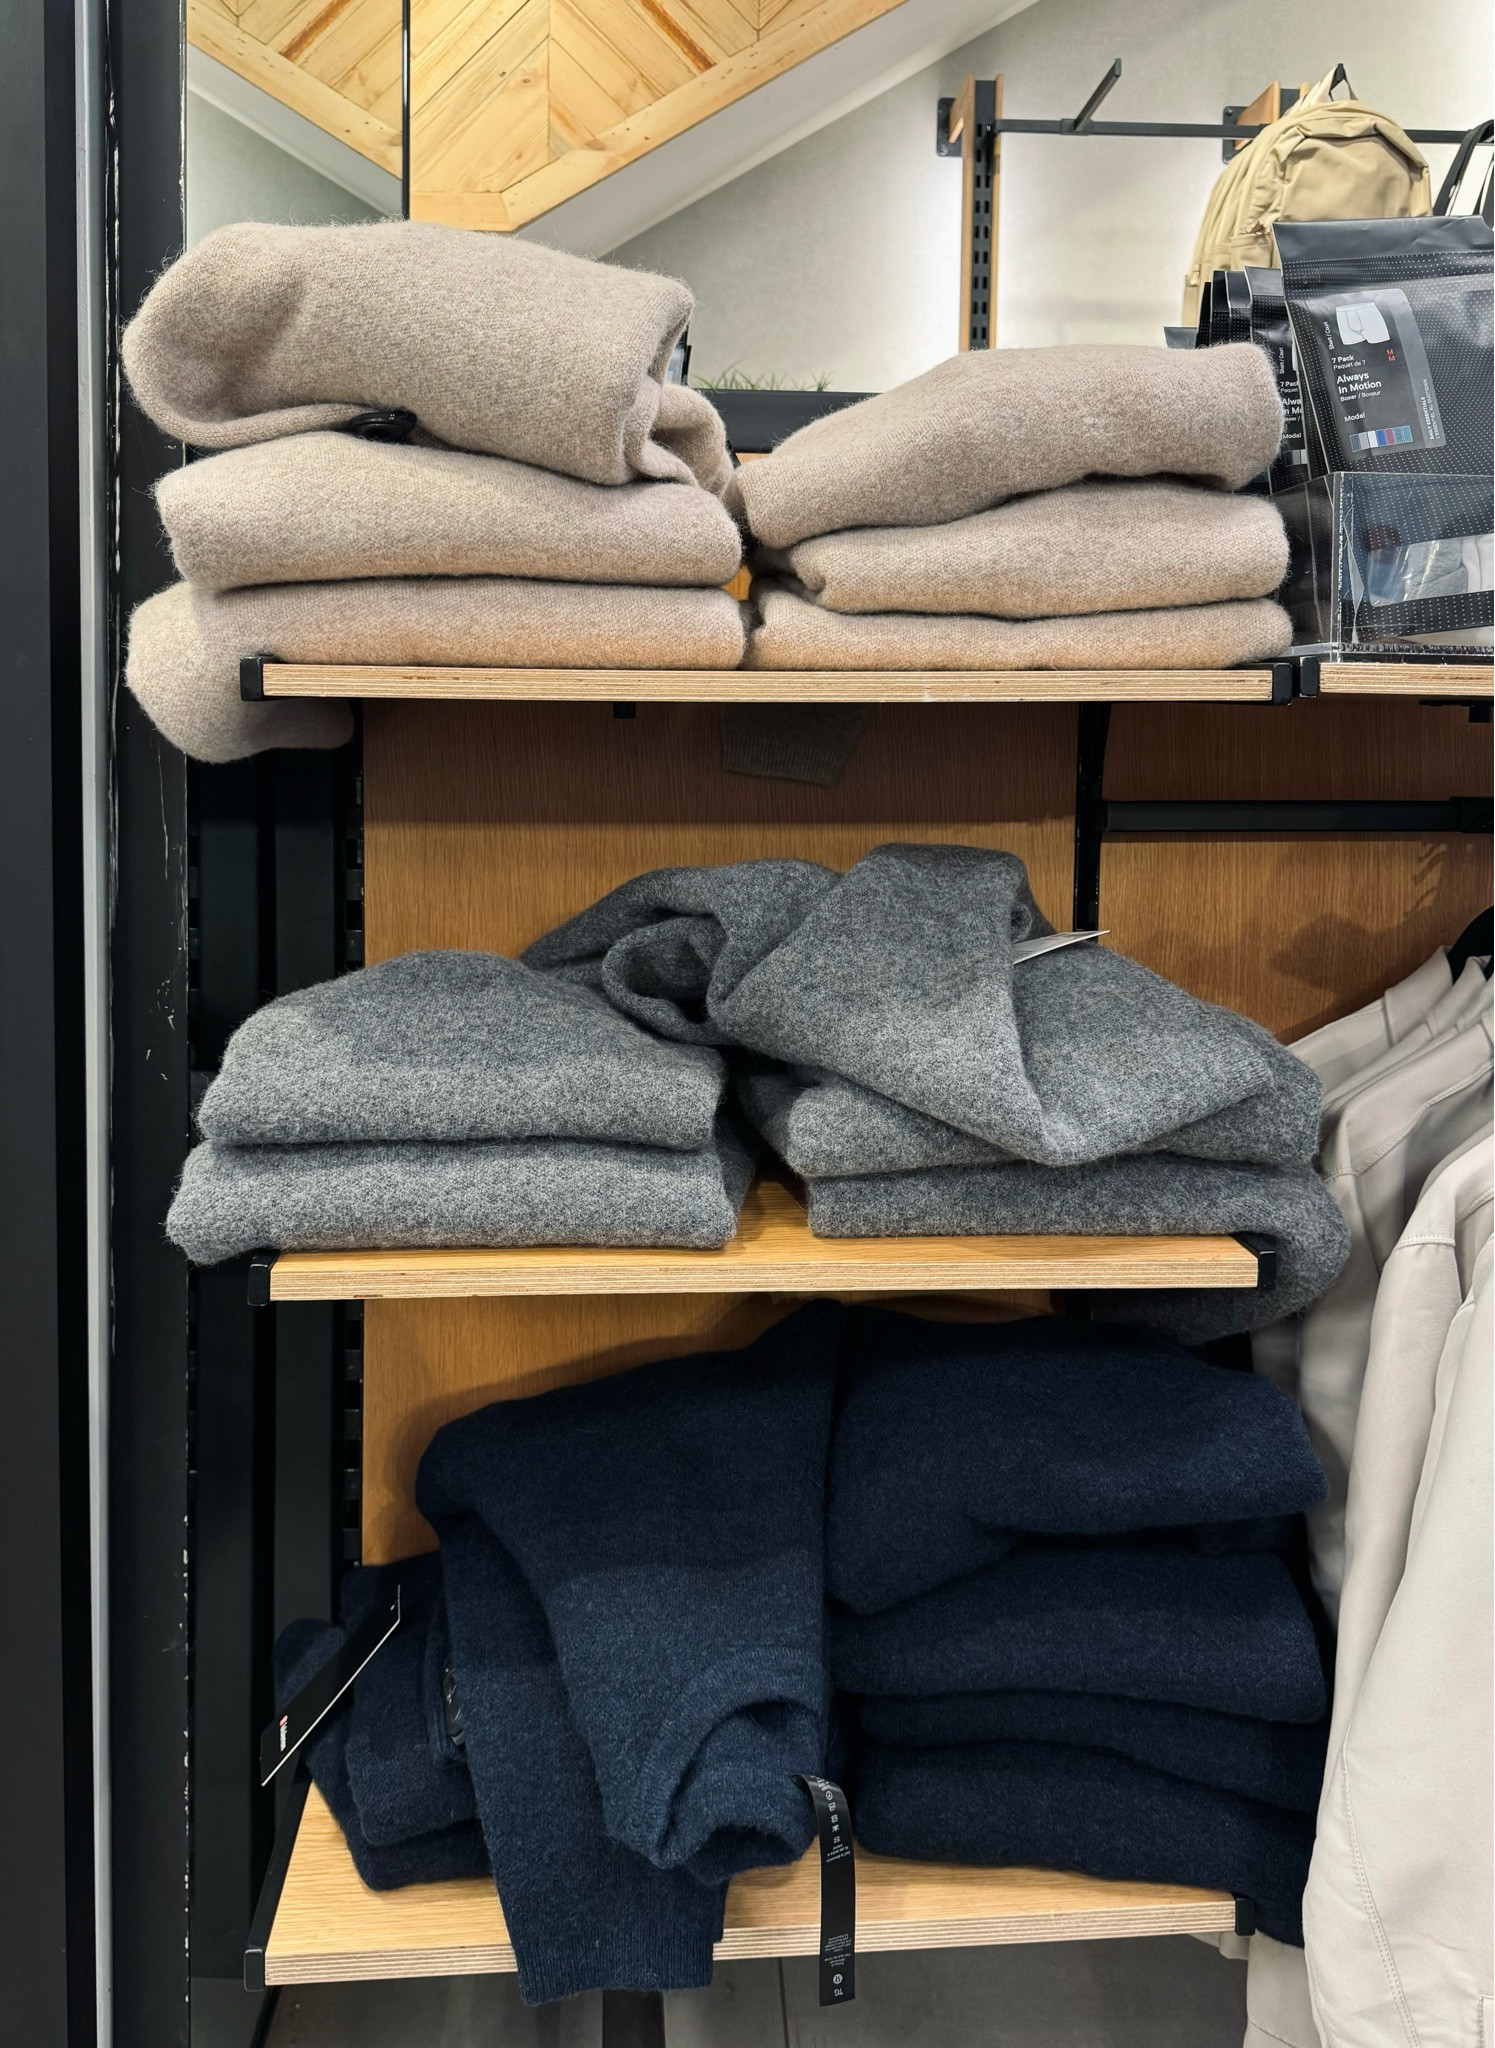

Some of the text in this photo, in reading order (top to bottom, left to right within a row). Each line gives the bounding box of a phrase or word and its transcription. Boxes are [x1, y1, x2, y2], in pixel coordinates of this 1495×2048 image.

[1337, 355, 1355, 363] Pack
[1333, 362, 1354, 370] Paquet
[1336, 372, 1370, 385] Always
[1338, 380, 1382, 395] In Motion
[1340, 394, 1357, 403] Boxer
[1361, 390, 1381, 398] Boxeur
[1344, 411, 1366, 422] Modal
[1282, 432, 1302, 440] Modal
